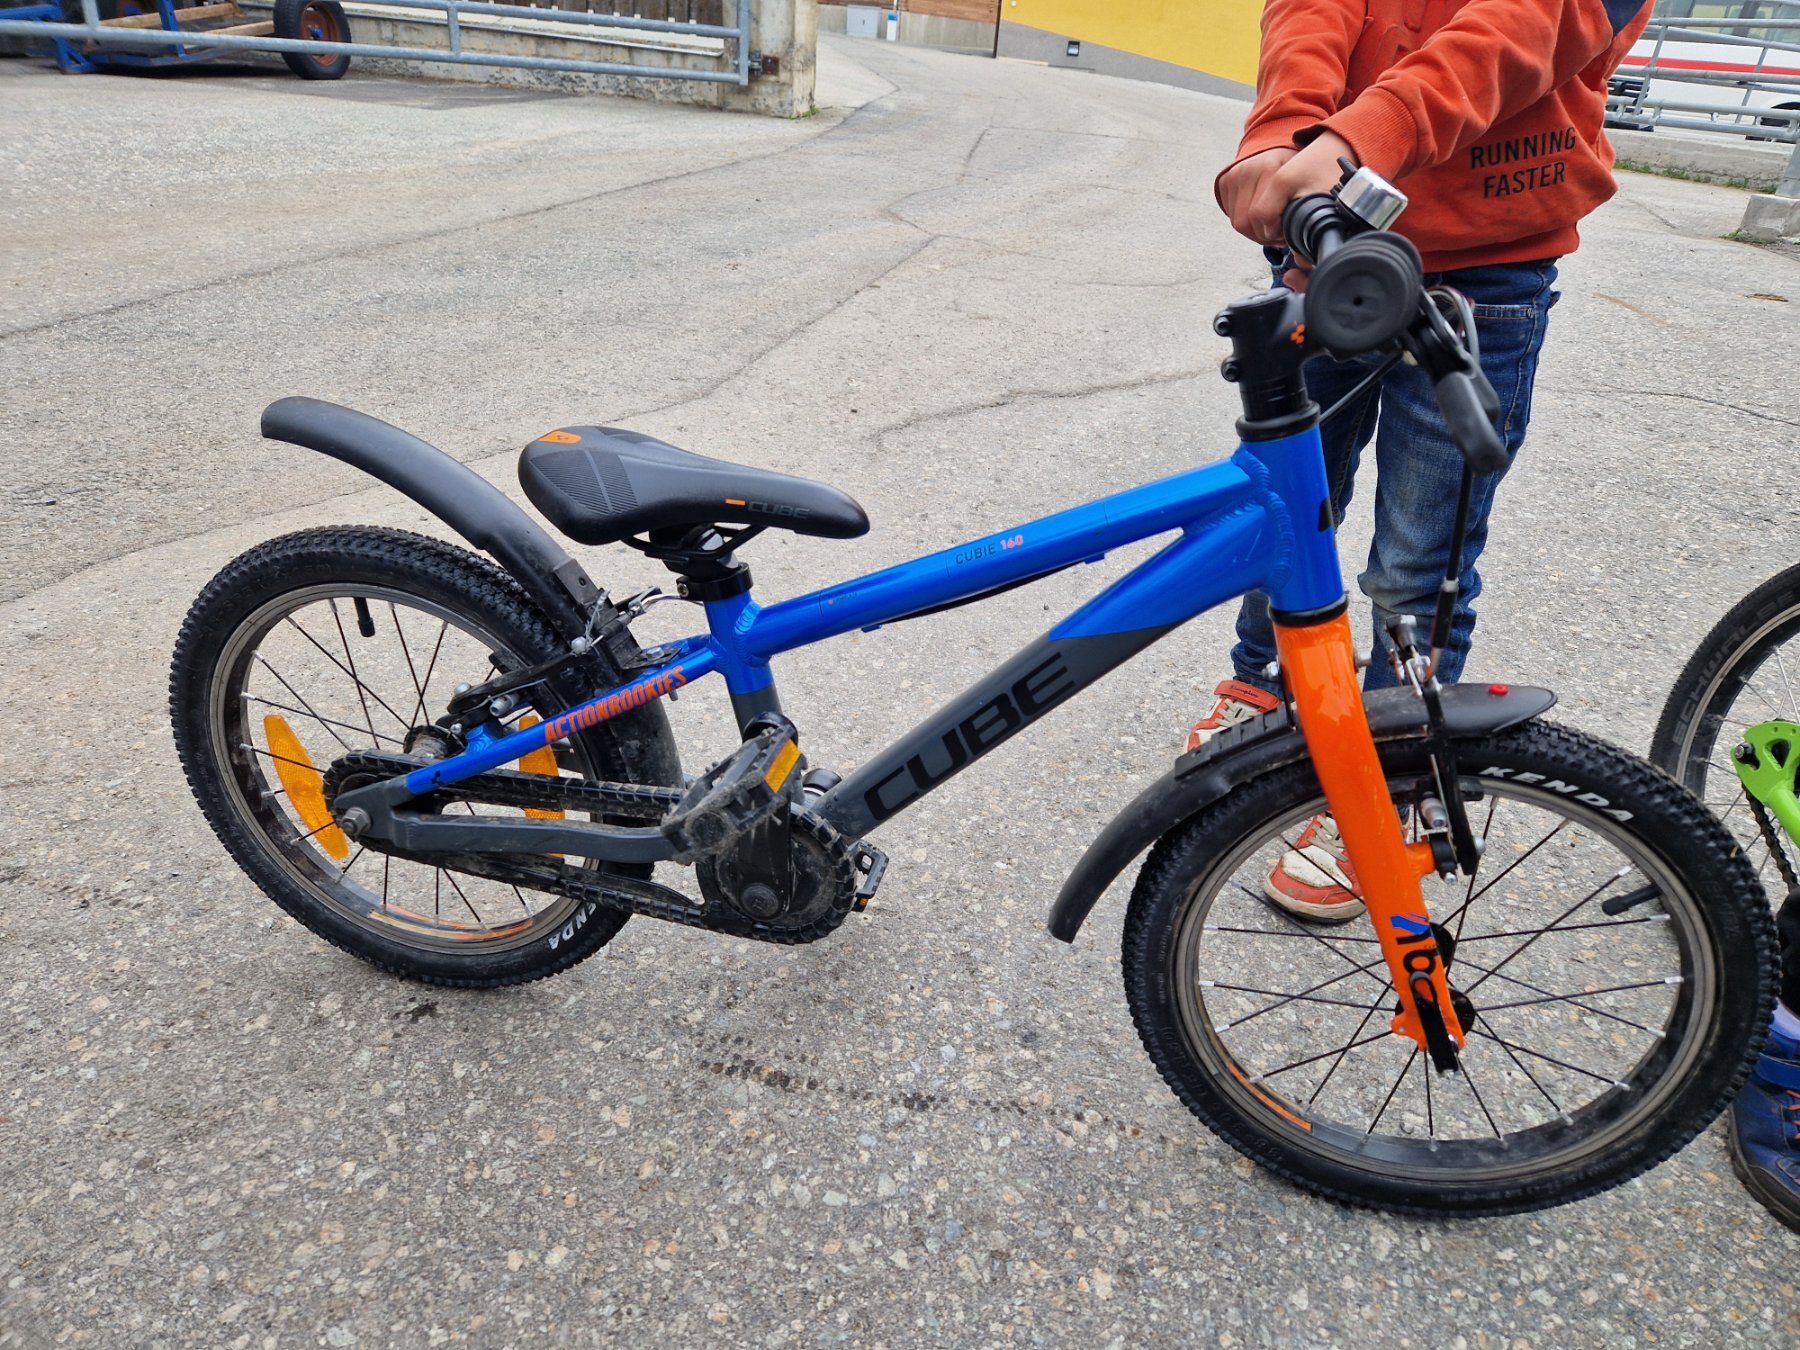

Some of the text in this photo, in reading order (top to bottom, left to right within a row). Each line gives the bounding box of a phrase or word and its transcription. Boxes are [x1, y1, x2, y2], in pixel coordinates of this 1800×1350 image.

[1470, 126, 1577, 169] RUNNING
[1483, 161, 1566, 198] FASTER
[747, 501, 810, 519] CUBE
[955, 534, 1024, 565] CUBIE 160
[1672, 590, 1794, 746] SCHWALBE
[544, 665, 687, 743] ACTIONROOKIES
[863, 651, 1076, 821] CUBE
[1478, 766, 1635, 822] KENDA
[548, 902, 597, 950] ENDA
